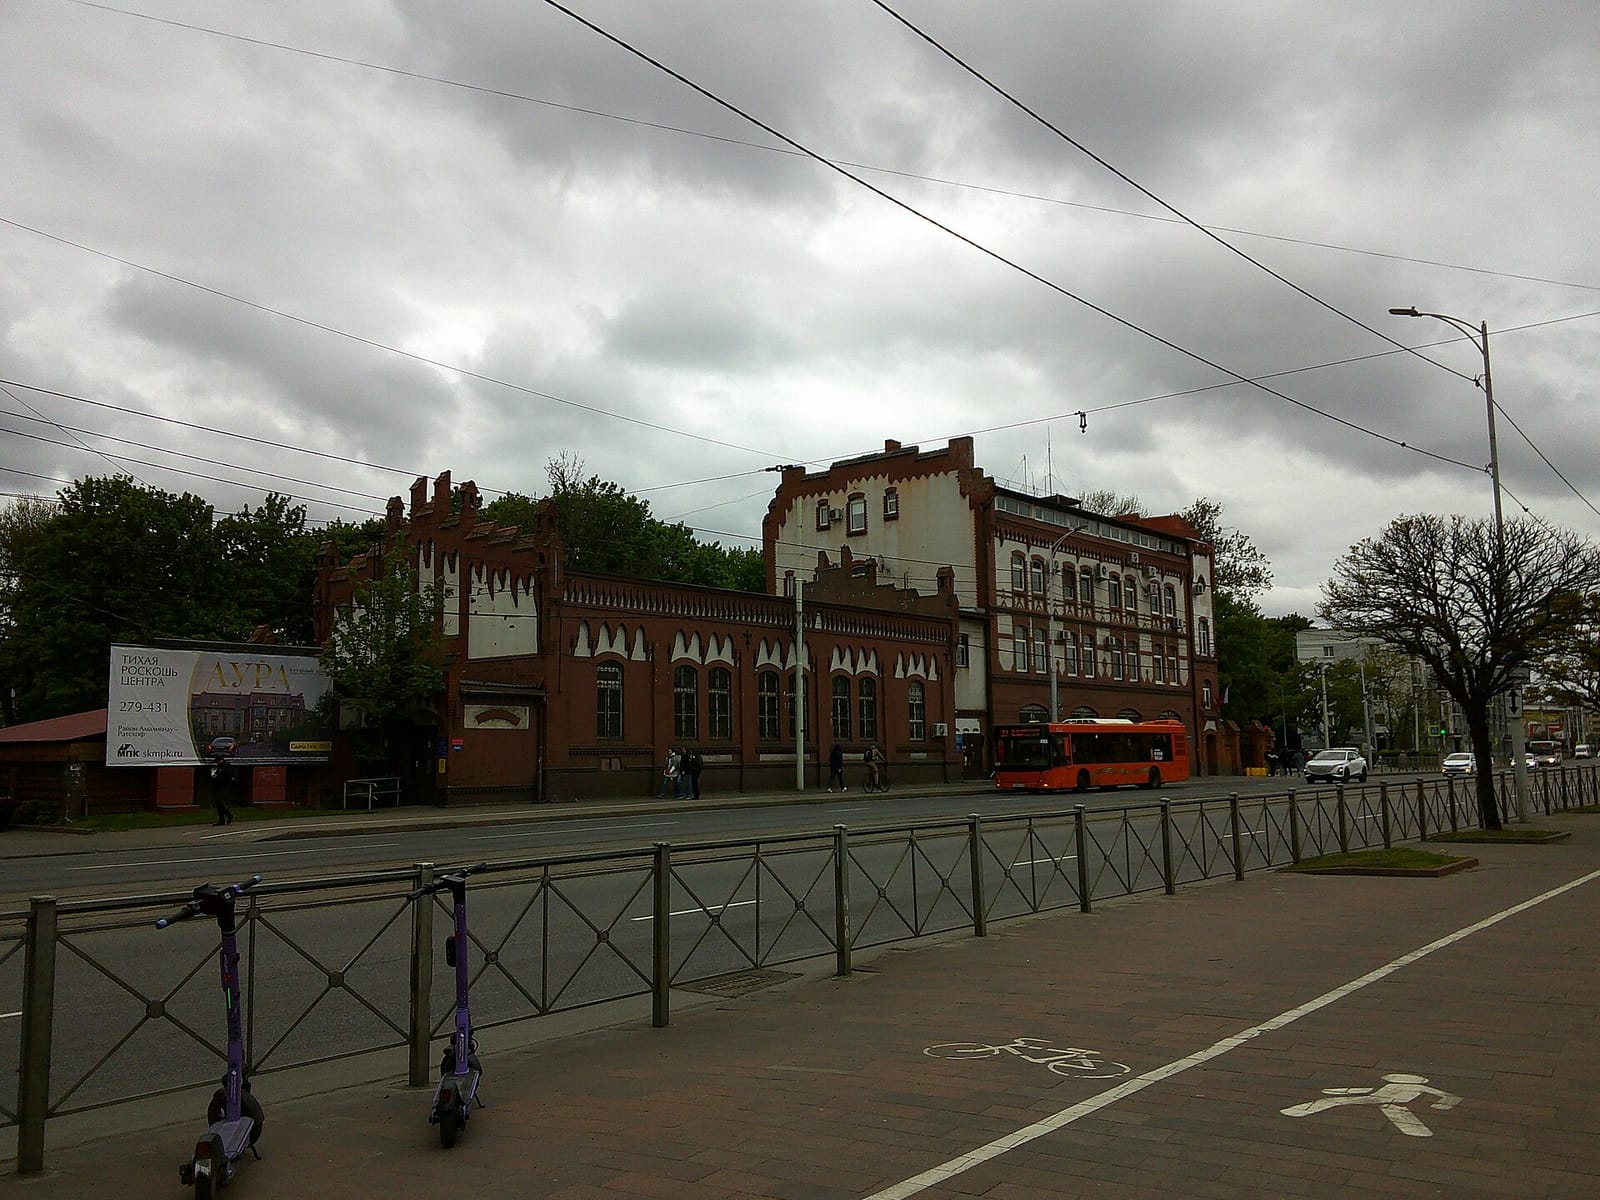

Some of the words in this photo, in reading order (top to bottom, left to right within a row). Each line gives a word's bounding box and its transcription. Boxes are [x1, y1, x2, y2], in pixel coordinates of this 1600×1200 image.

[121, 655, 158, 666] ТИХАЯ
[121, 666, 178, 677] РОСКОШЬ
[206, 657, 290, 692] АУРА
[121, 676, 165, 687] ЦЕНТРА
[119, 701, 169, 713] 279-431
[117, 749, 140, 758] МПК
[142, 748, 183, 759] skmpk.ru
